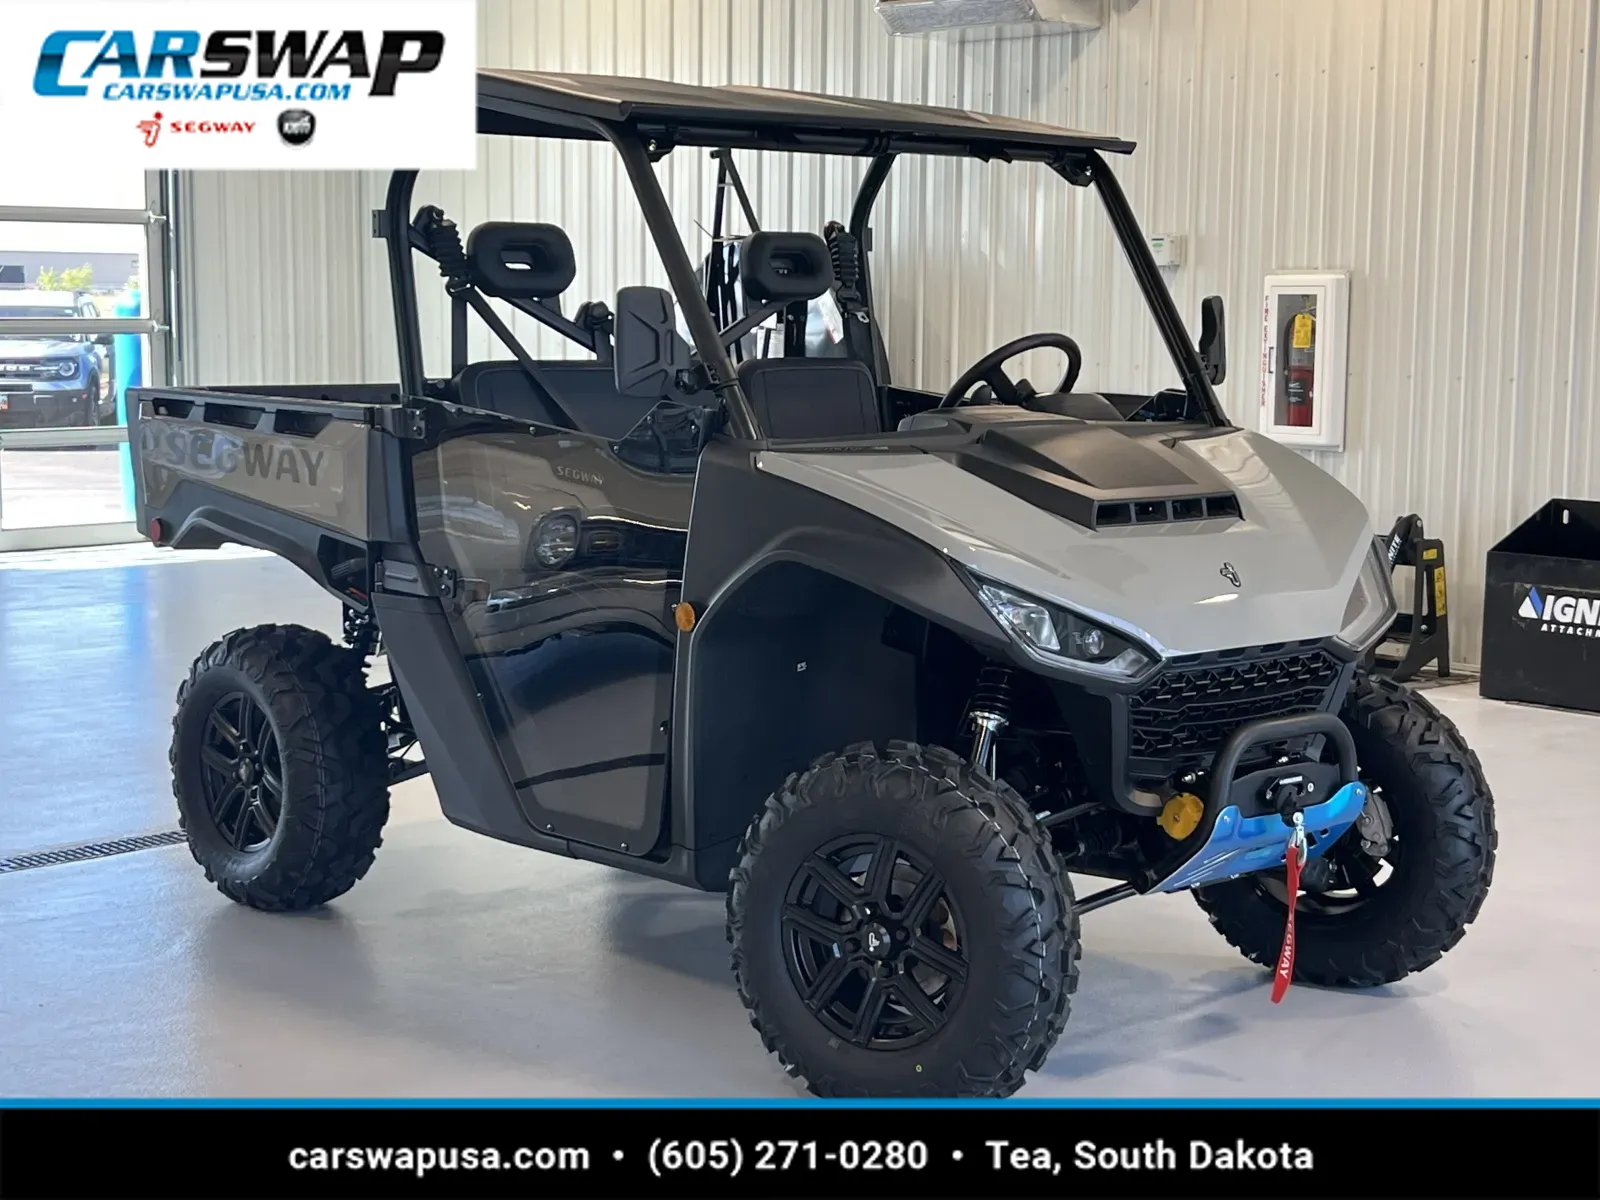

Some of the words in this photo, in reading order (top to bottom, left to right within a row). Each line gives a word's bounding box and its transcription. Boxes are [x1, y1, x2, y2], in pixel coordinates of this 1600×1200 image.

[166, 427, 324, 487] SEGWAY
[556, 465, 604, 486] SEGWAY
[1542, 594, 1600, 627] IGN
[1279, 912, 1293, 980] EGWAY
